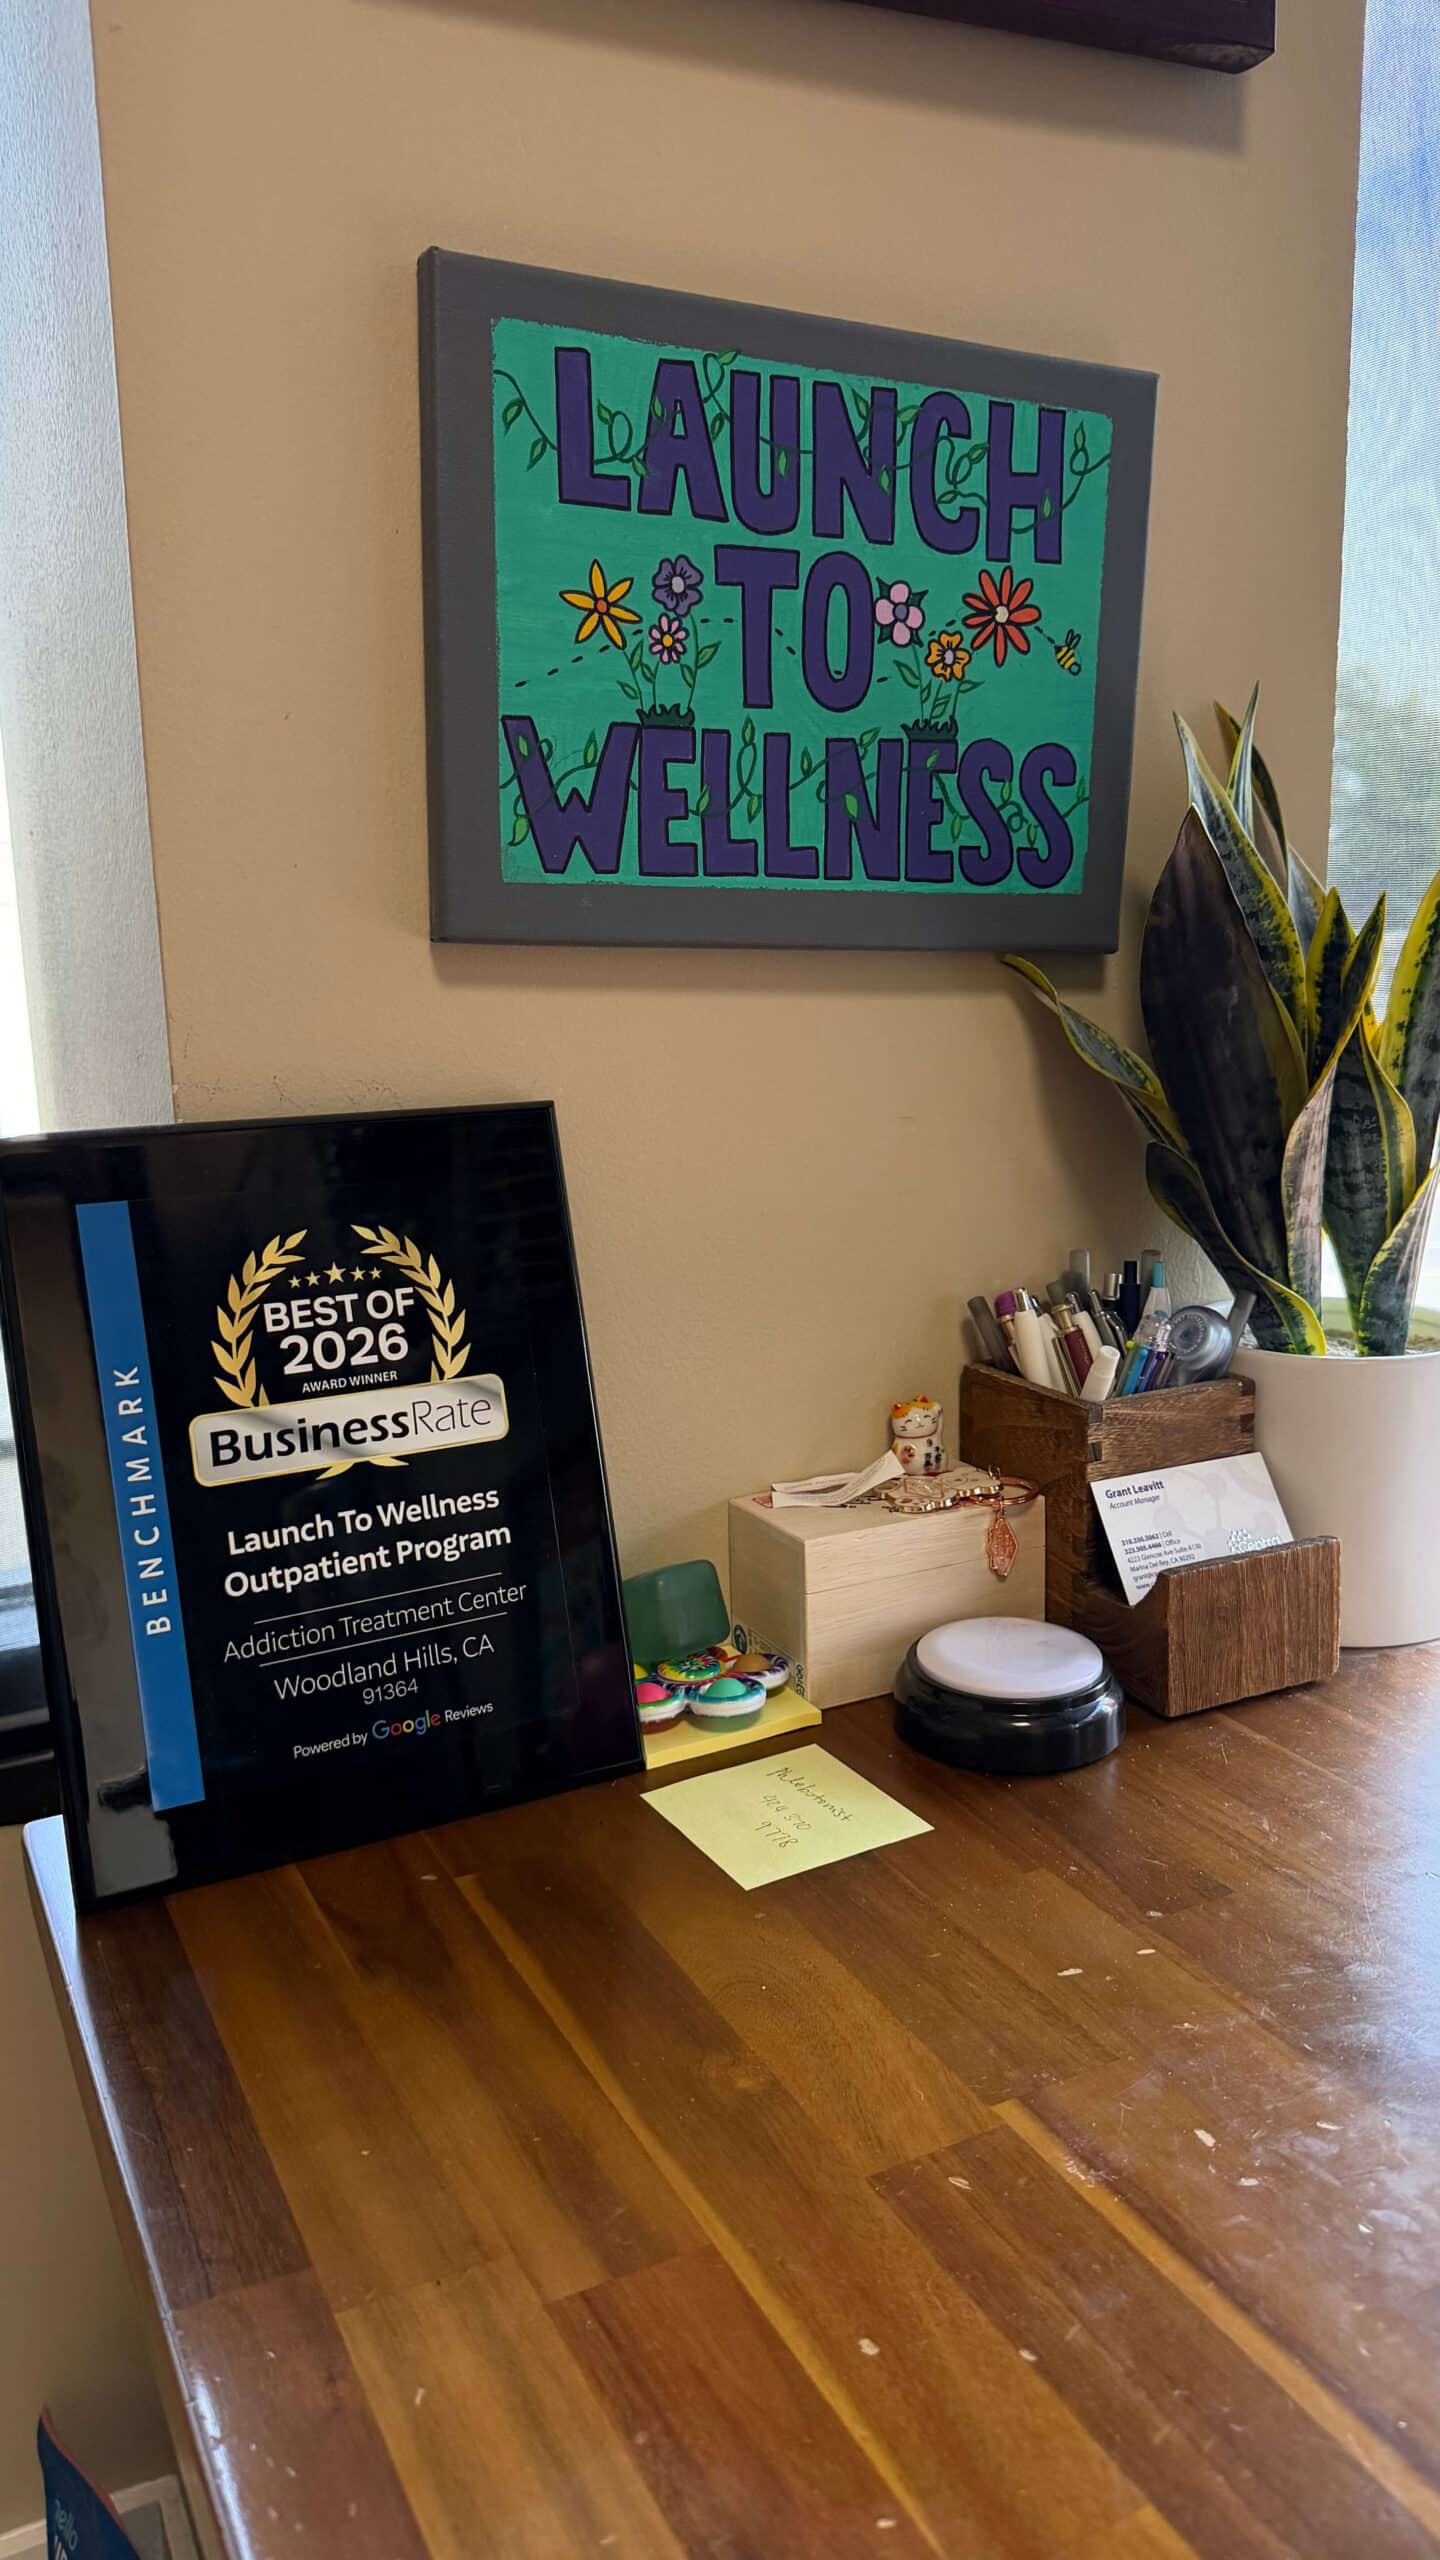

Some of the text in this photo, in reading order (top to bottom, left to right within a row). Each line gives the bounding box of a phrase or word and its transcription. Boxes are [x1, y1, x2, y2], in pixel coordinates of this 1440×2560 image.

[553, 346, 1066, 565] LAUNCH
[714, 544, 875, 712] TO
[500, 715, 1078, 889] WELLNESS
[263, 1287, 415, 1333] BEST OF
[279, 1322, 409, 1375] 2026
[302, 1370, 398, 1394] AWARD WINNER
[209, 1398, 492, 1467] BusinessRate
[113, 1366, 172, 1635] BENCHMARK
[1105, 1480, 1165, 1499] Grant Leavitt
[1109, 1493, 1161, 1510] Account Manager
[227, 1490, 500, 1556] Launch To Wellness
[224, 1526, 511, 1597] Outpatient Program
[1130, 1563, 1149, 1572] Marina
[224, 1584, 527, 1663] Addiction Treatment Center
[274, 1633, 495, 1700] Woodland Hills, CA
[362, 1678, 419, 1706] 91364
[293, 1701, 494, 1760] Powered by Google Reviews
